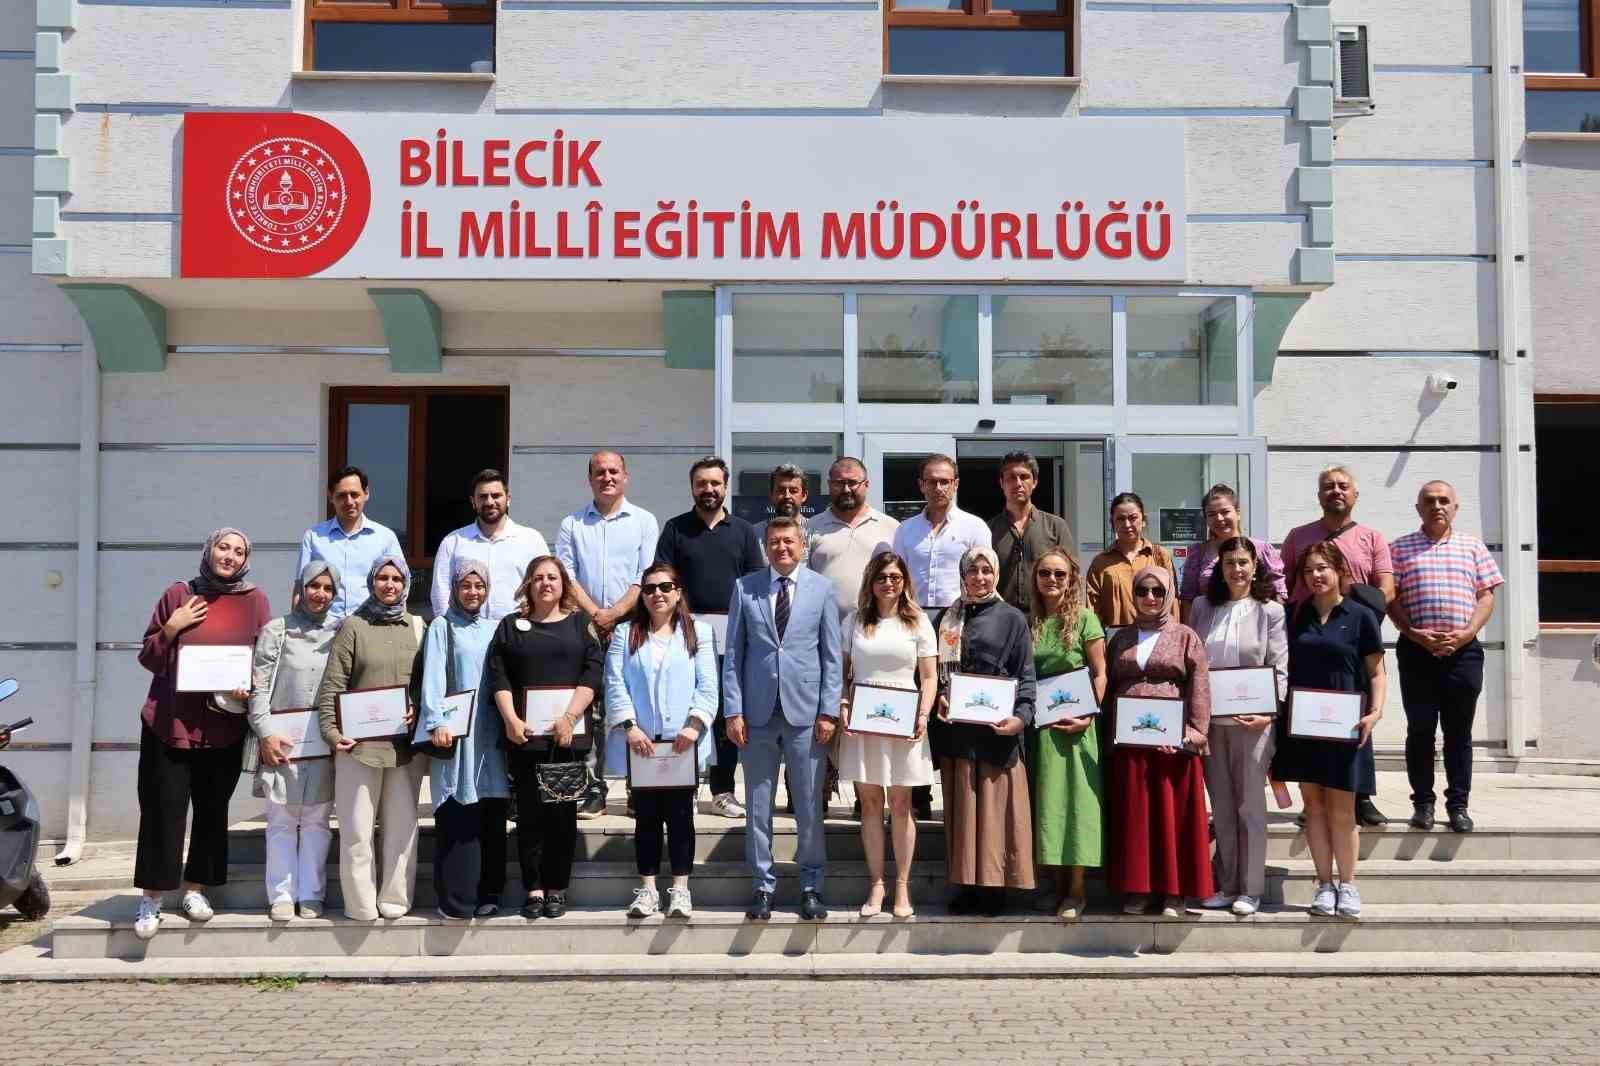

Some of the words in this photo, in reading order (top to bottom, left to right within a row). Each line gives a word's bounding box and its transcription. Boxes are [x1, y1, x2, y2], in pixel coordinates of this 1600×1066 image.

[400, 127, 602, 187] BİLECİK
[400, 200, 444, 257] İL
[458, 200, 603, 257] MİLLÎ
[613, 199, 801, 258] EĞİTİM
[821, 199, 1172, 260] MÜDÜRLÜĞÜ
